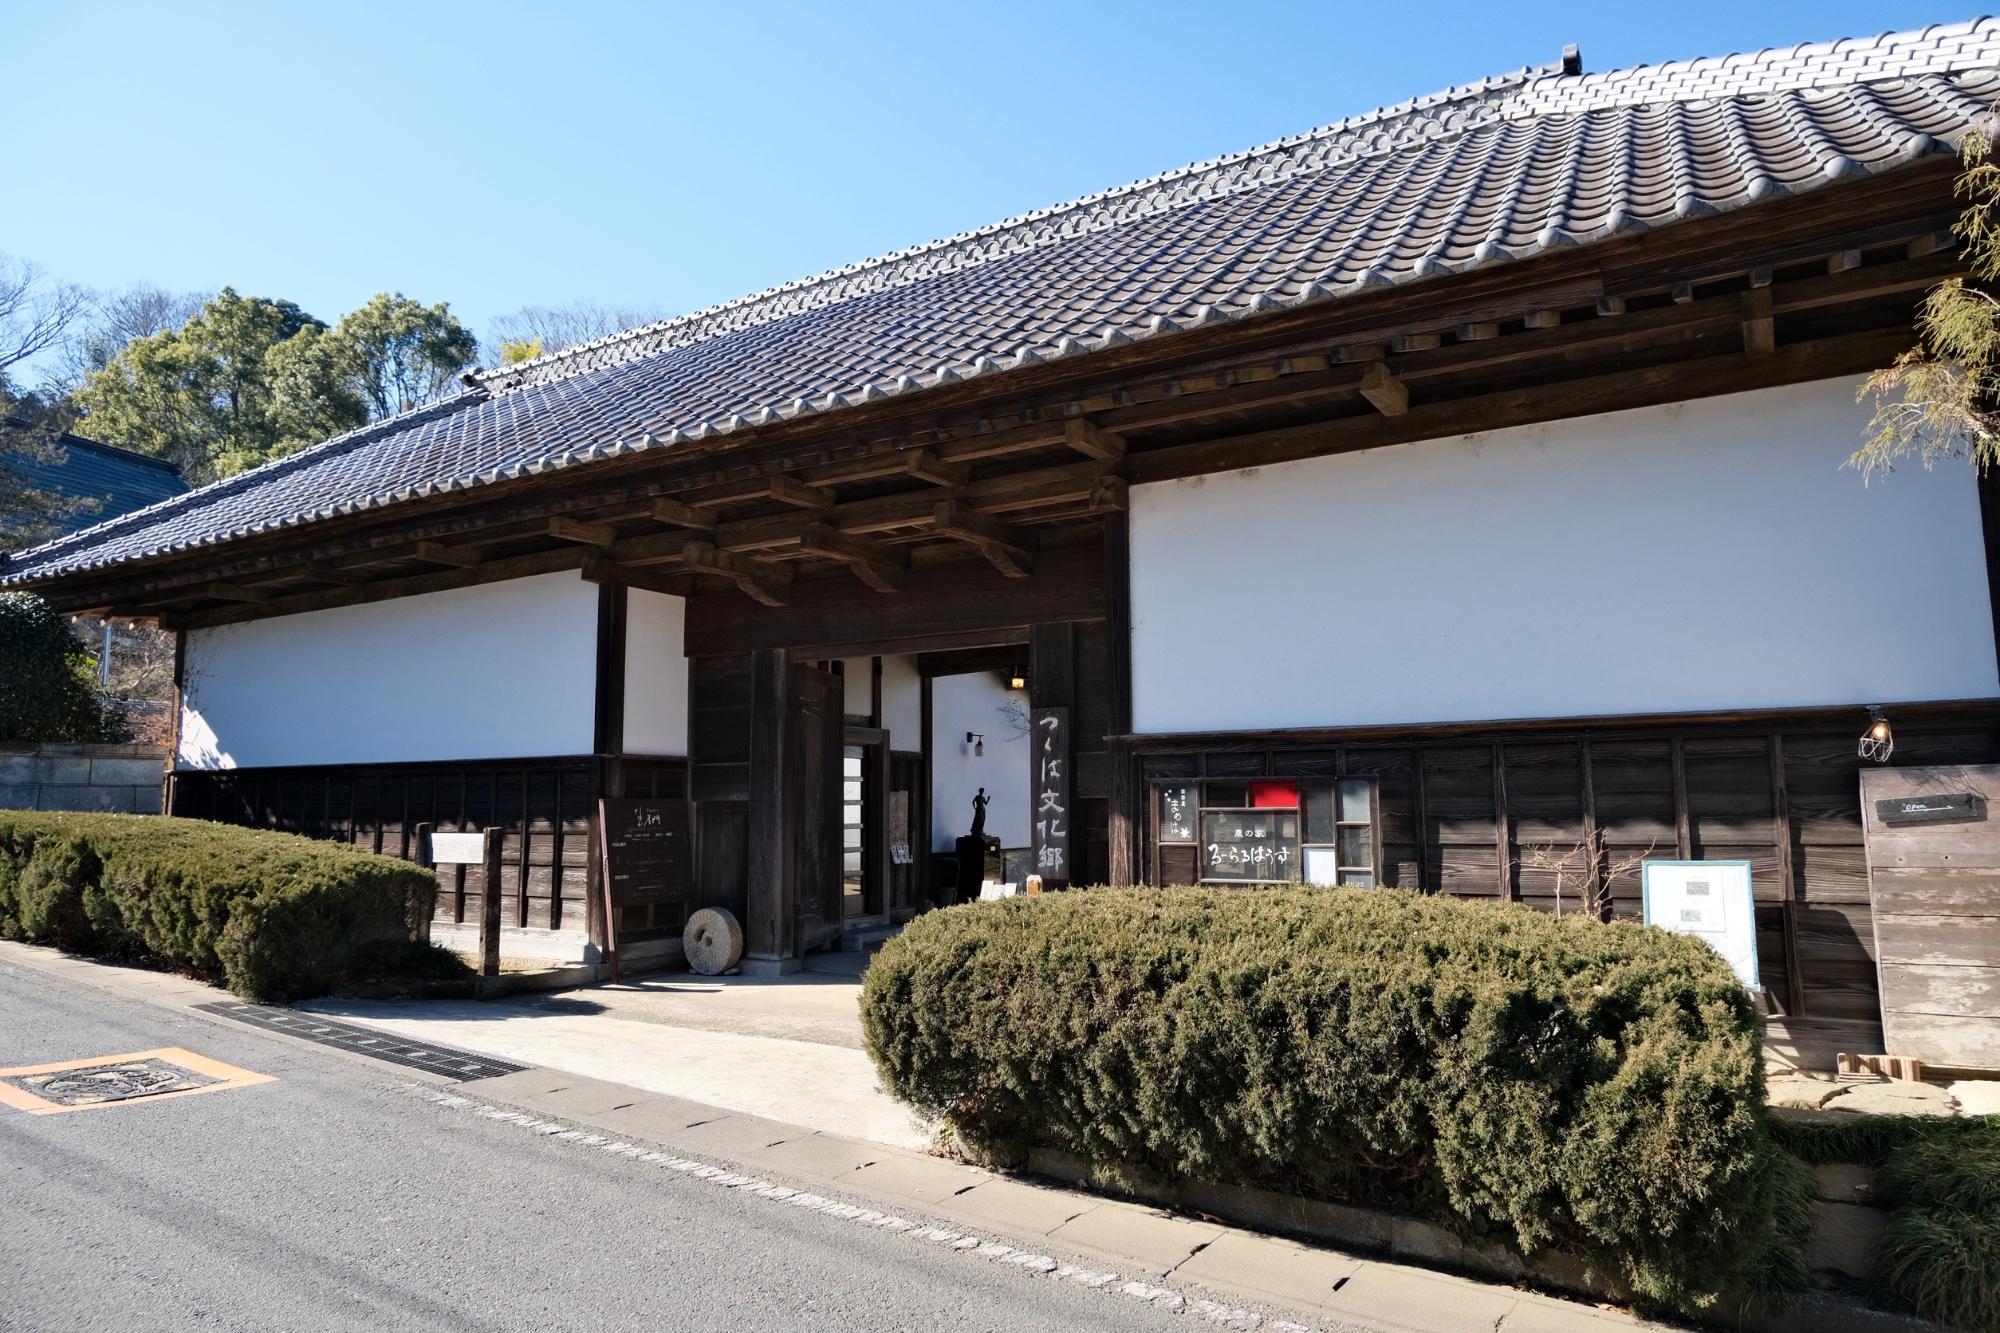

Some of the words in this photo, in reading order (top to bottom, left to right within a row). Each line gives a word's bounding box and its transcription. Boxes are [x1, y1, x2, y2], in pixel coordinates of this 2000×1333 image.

[1036, 716, 1066, 872] つくば文化郷
[1208, 843, 1291, 866] るーらるはうす
